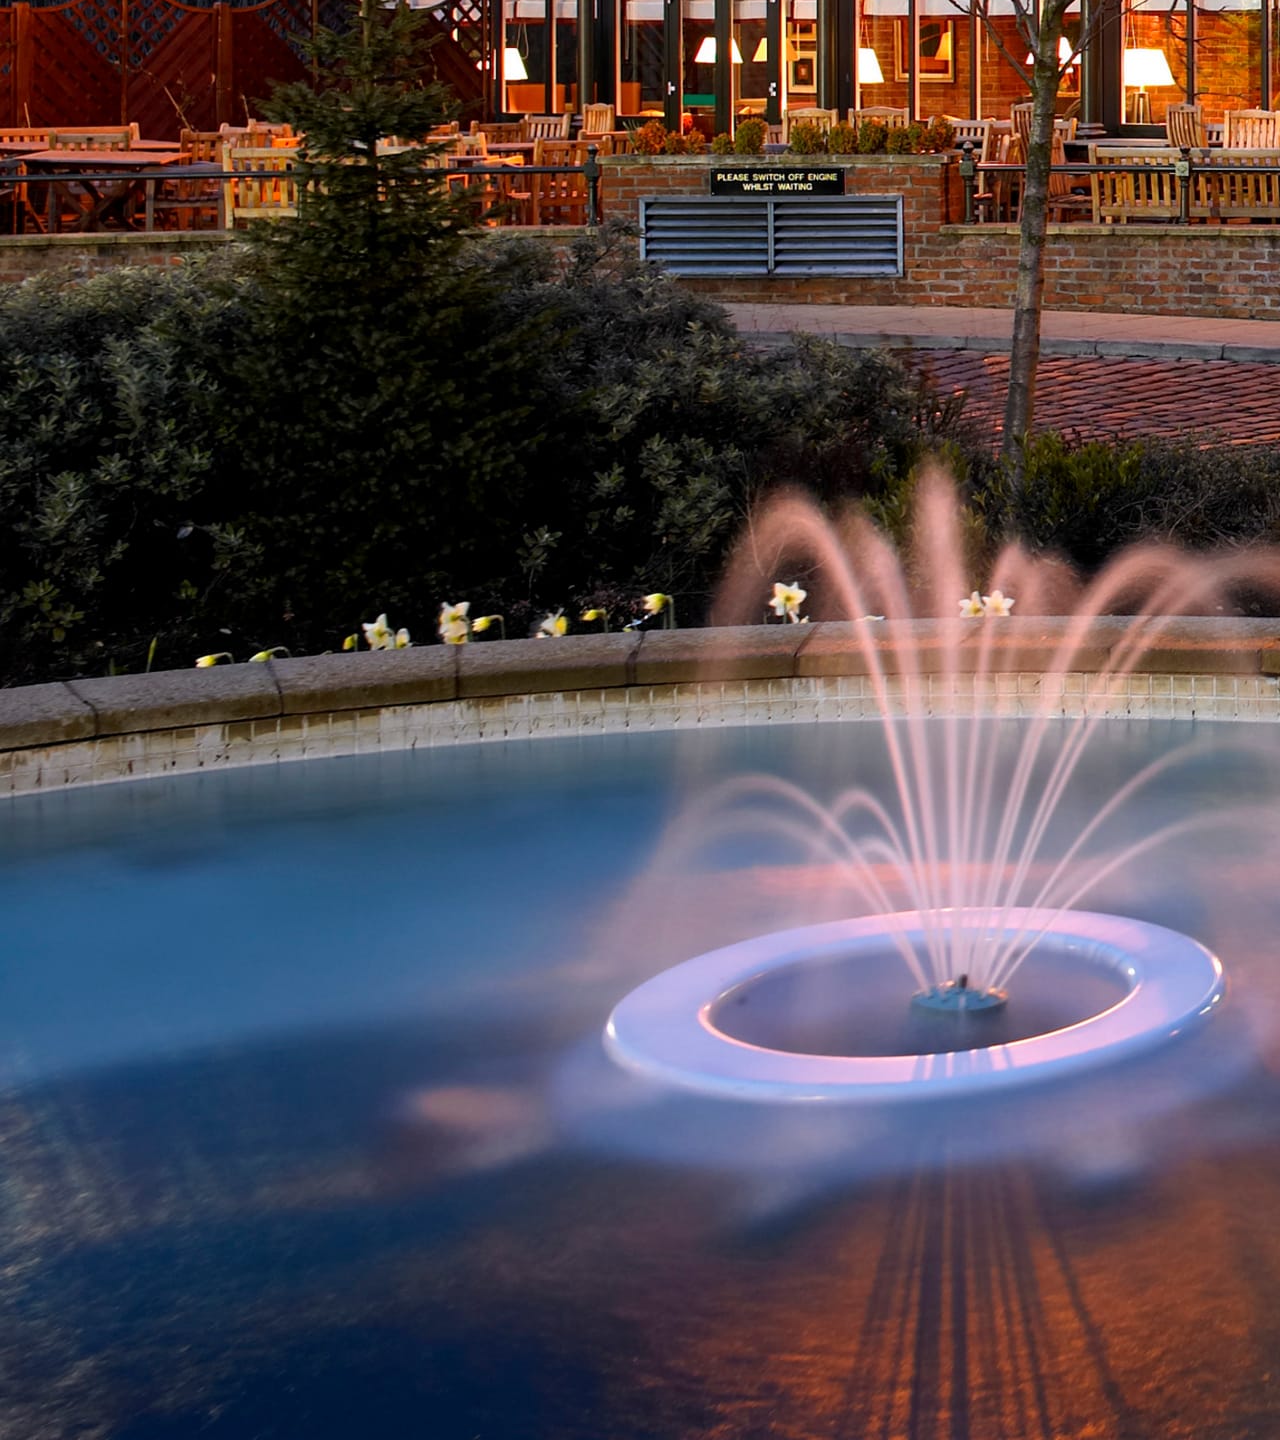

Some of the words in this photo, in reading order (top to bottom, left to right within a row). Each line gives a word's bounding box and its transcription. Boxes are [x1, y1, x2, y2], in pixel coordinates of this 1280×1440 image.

[717, 173, 749, 181] PLEASE
[752, 173, 785, 181] SWITCH
[788, 173, 804, 181] OFF
[808, 173, 837, 181] ENGINE
[743, 183, 774, 191] WHILST
[777, 183, 813, 191] WAITING
